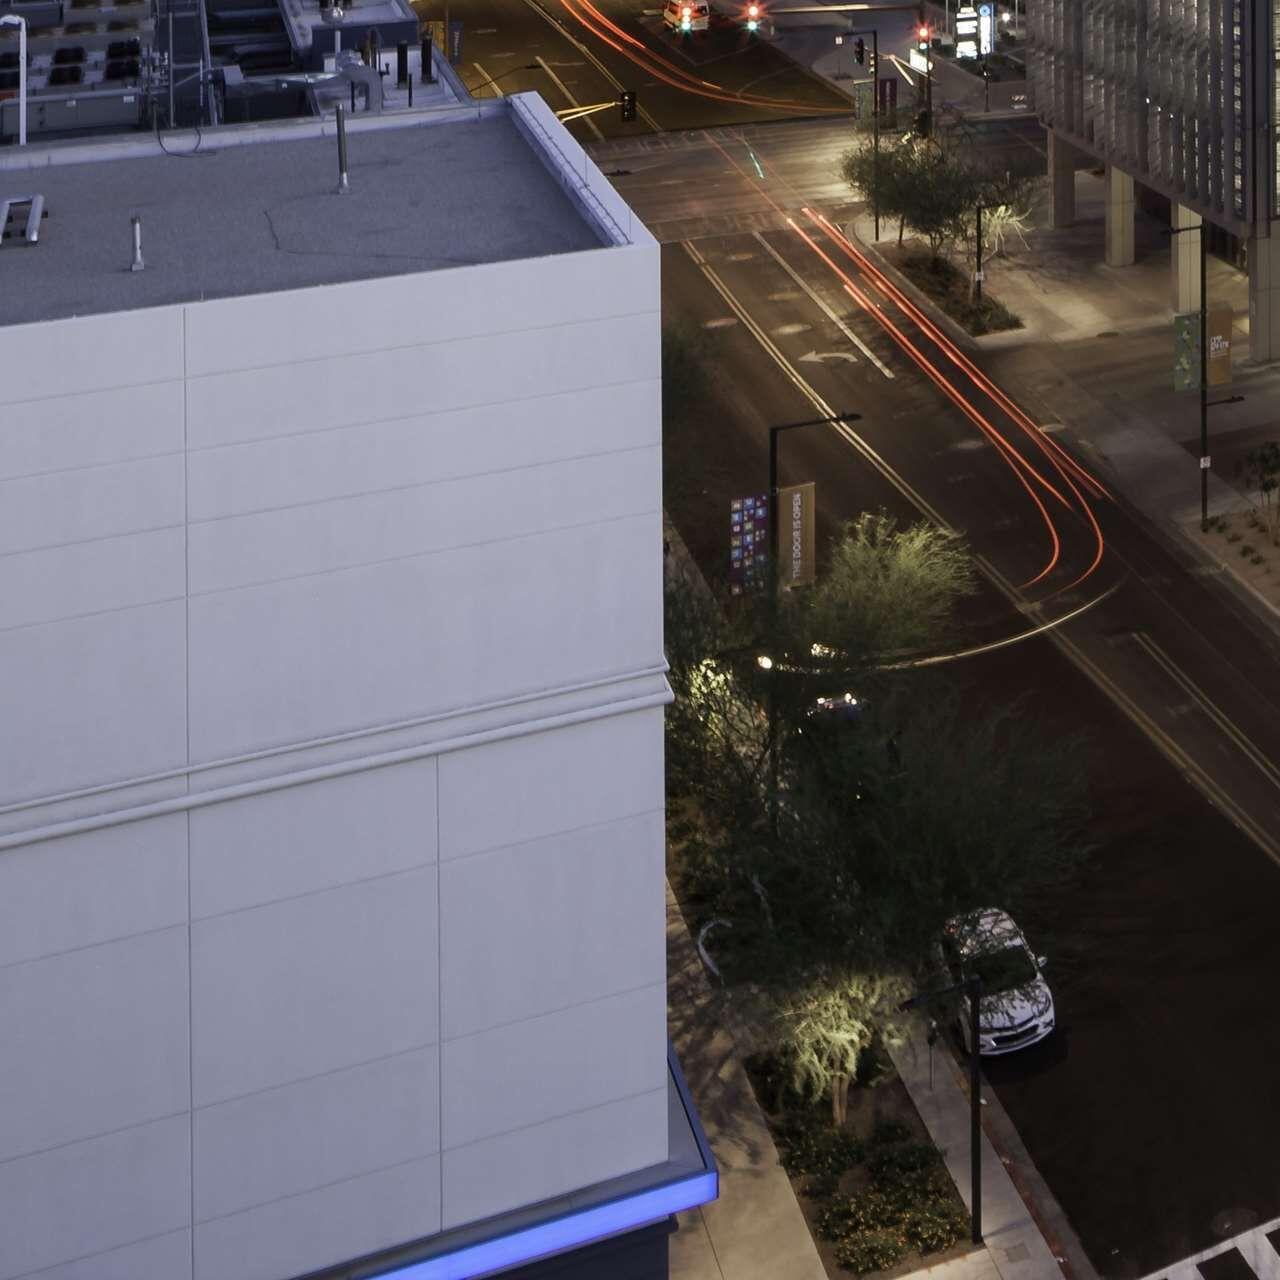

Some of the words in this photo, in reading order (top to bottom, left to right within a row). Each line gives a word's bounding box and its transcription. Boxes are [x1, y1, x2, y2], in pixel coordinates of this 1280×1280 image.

[793, 493, 802, 519] OPEN
[792, 530, 801, 558] DOOR
[792, 559, 801, 579] THE
